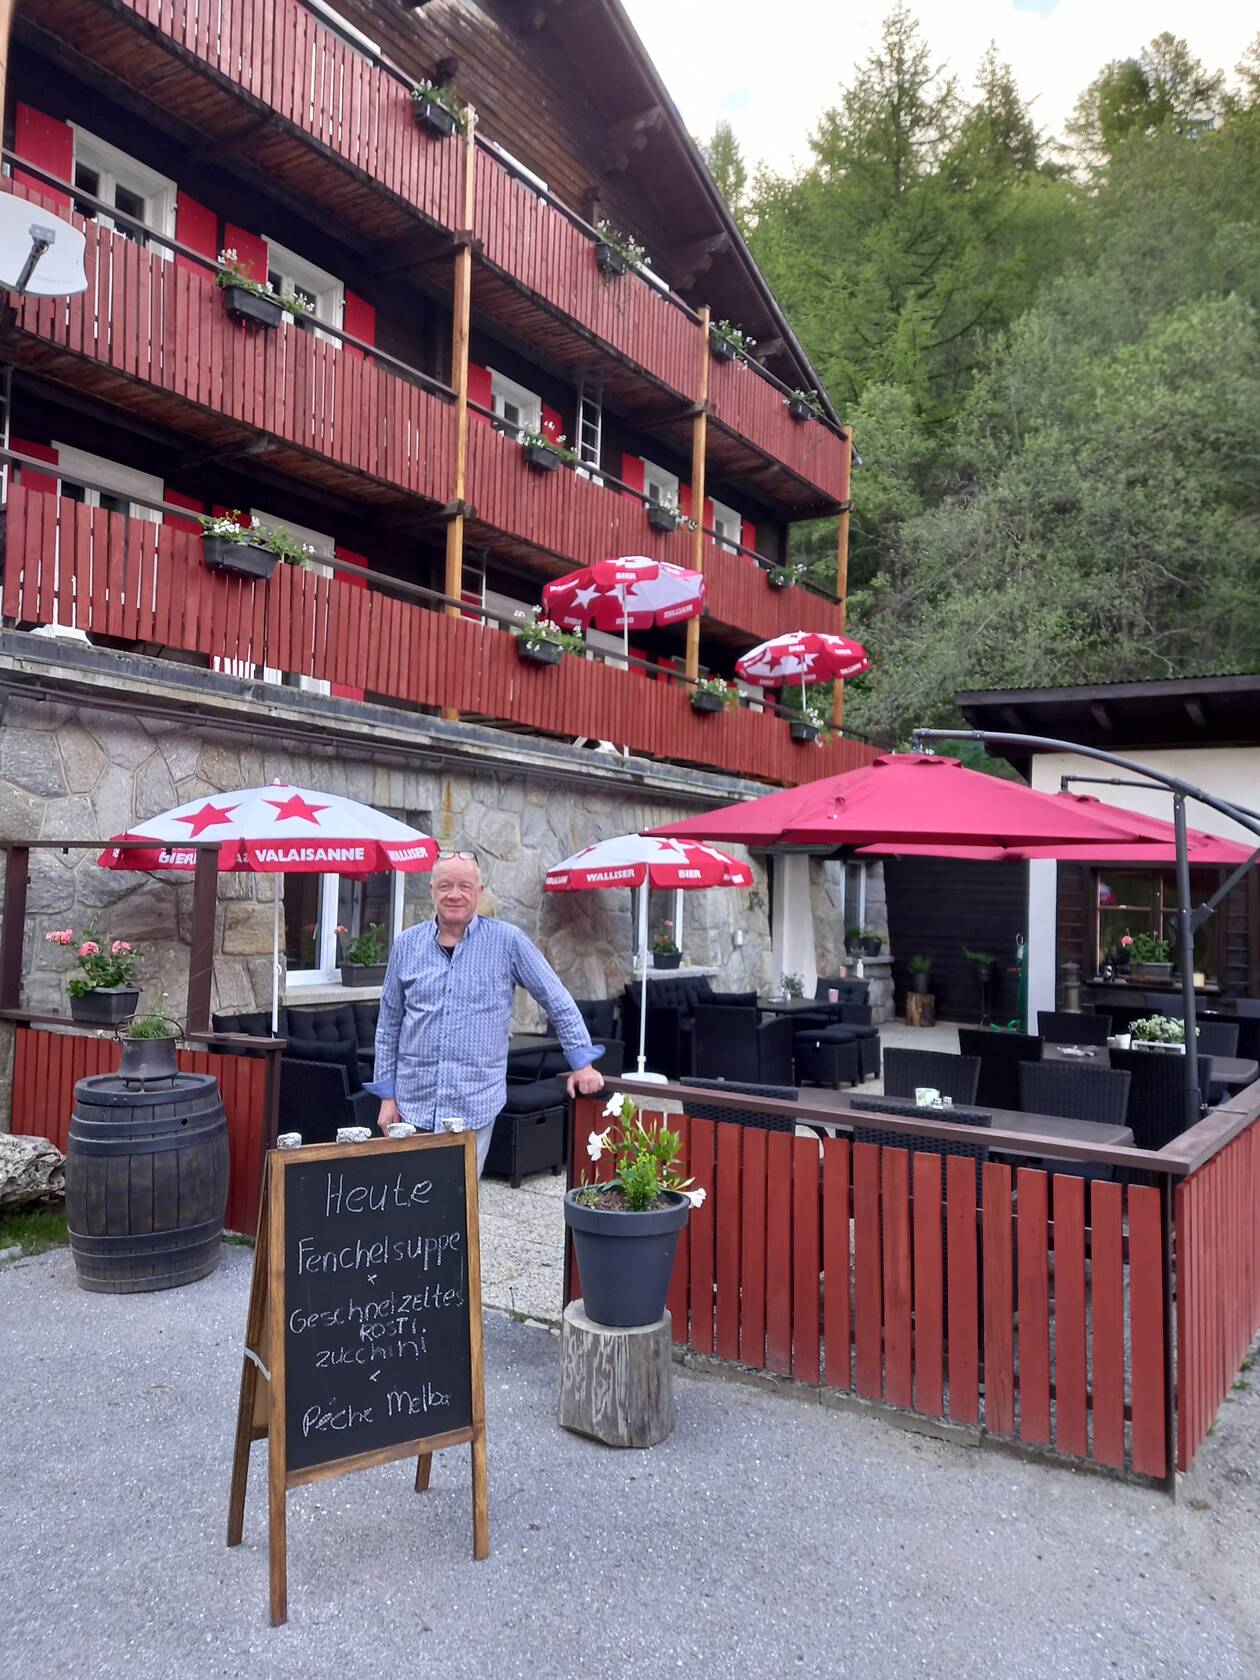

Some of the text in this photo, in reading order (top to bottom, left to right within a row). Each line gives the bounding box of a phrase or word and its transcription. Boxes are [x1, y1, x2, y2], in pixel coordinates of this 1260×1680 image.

[255, 848, 364, 862] VALAISANNE
[387, 847, 428, 862] WALLISER
[586, 869, 635, 882] WALLISER
[678, 869, 702, 879] BIER
[326, 1173, 432, 1217] Heute
[298, 1232, 461, 1275] Fenchelsuppe
